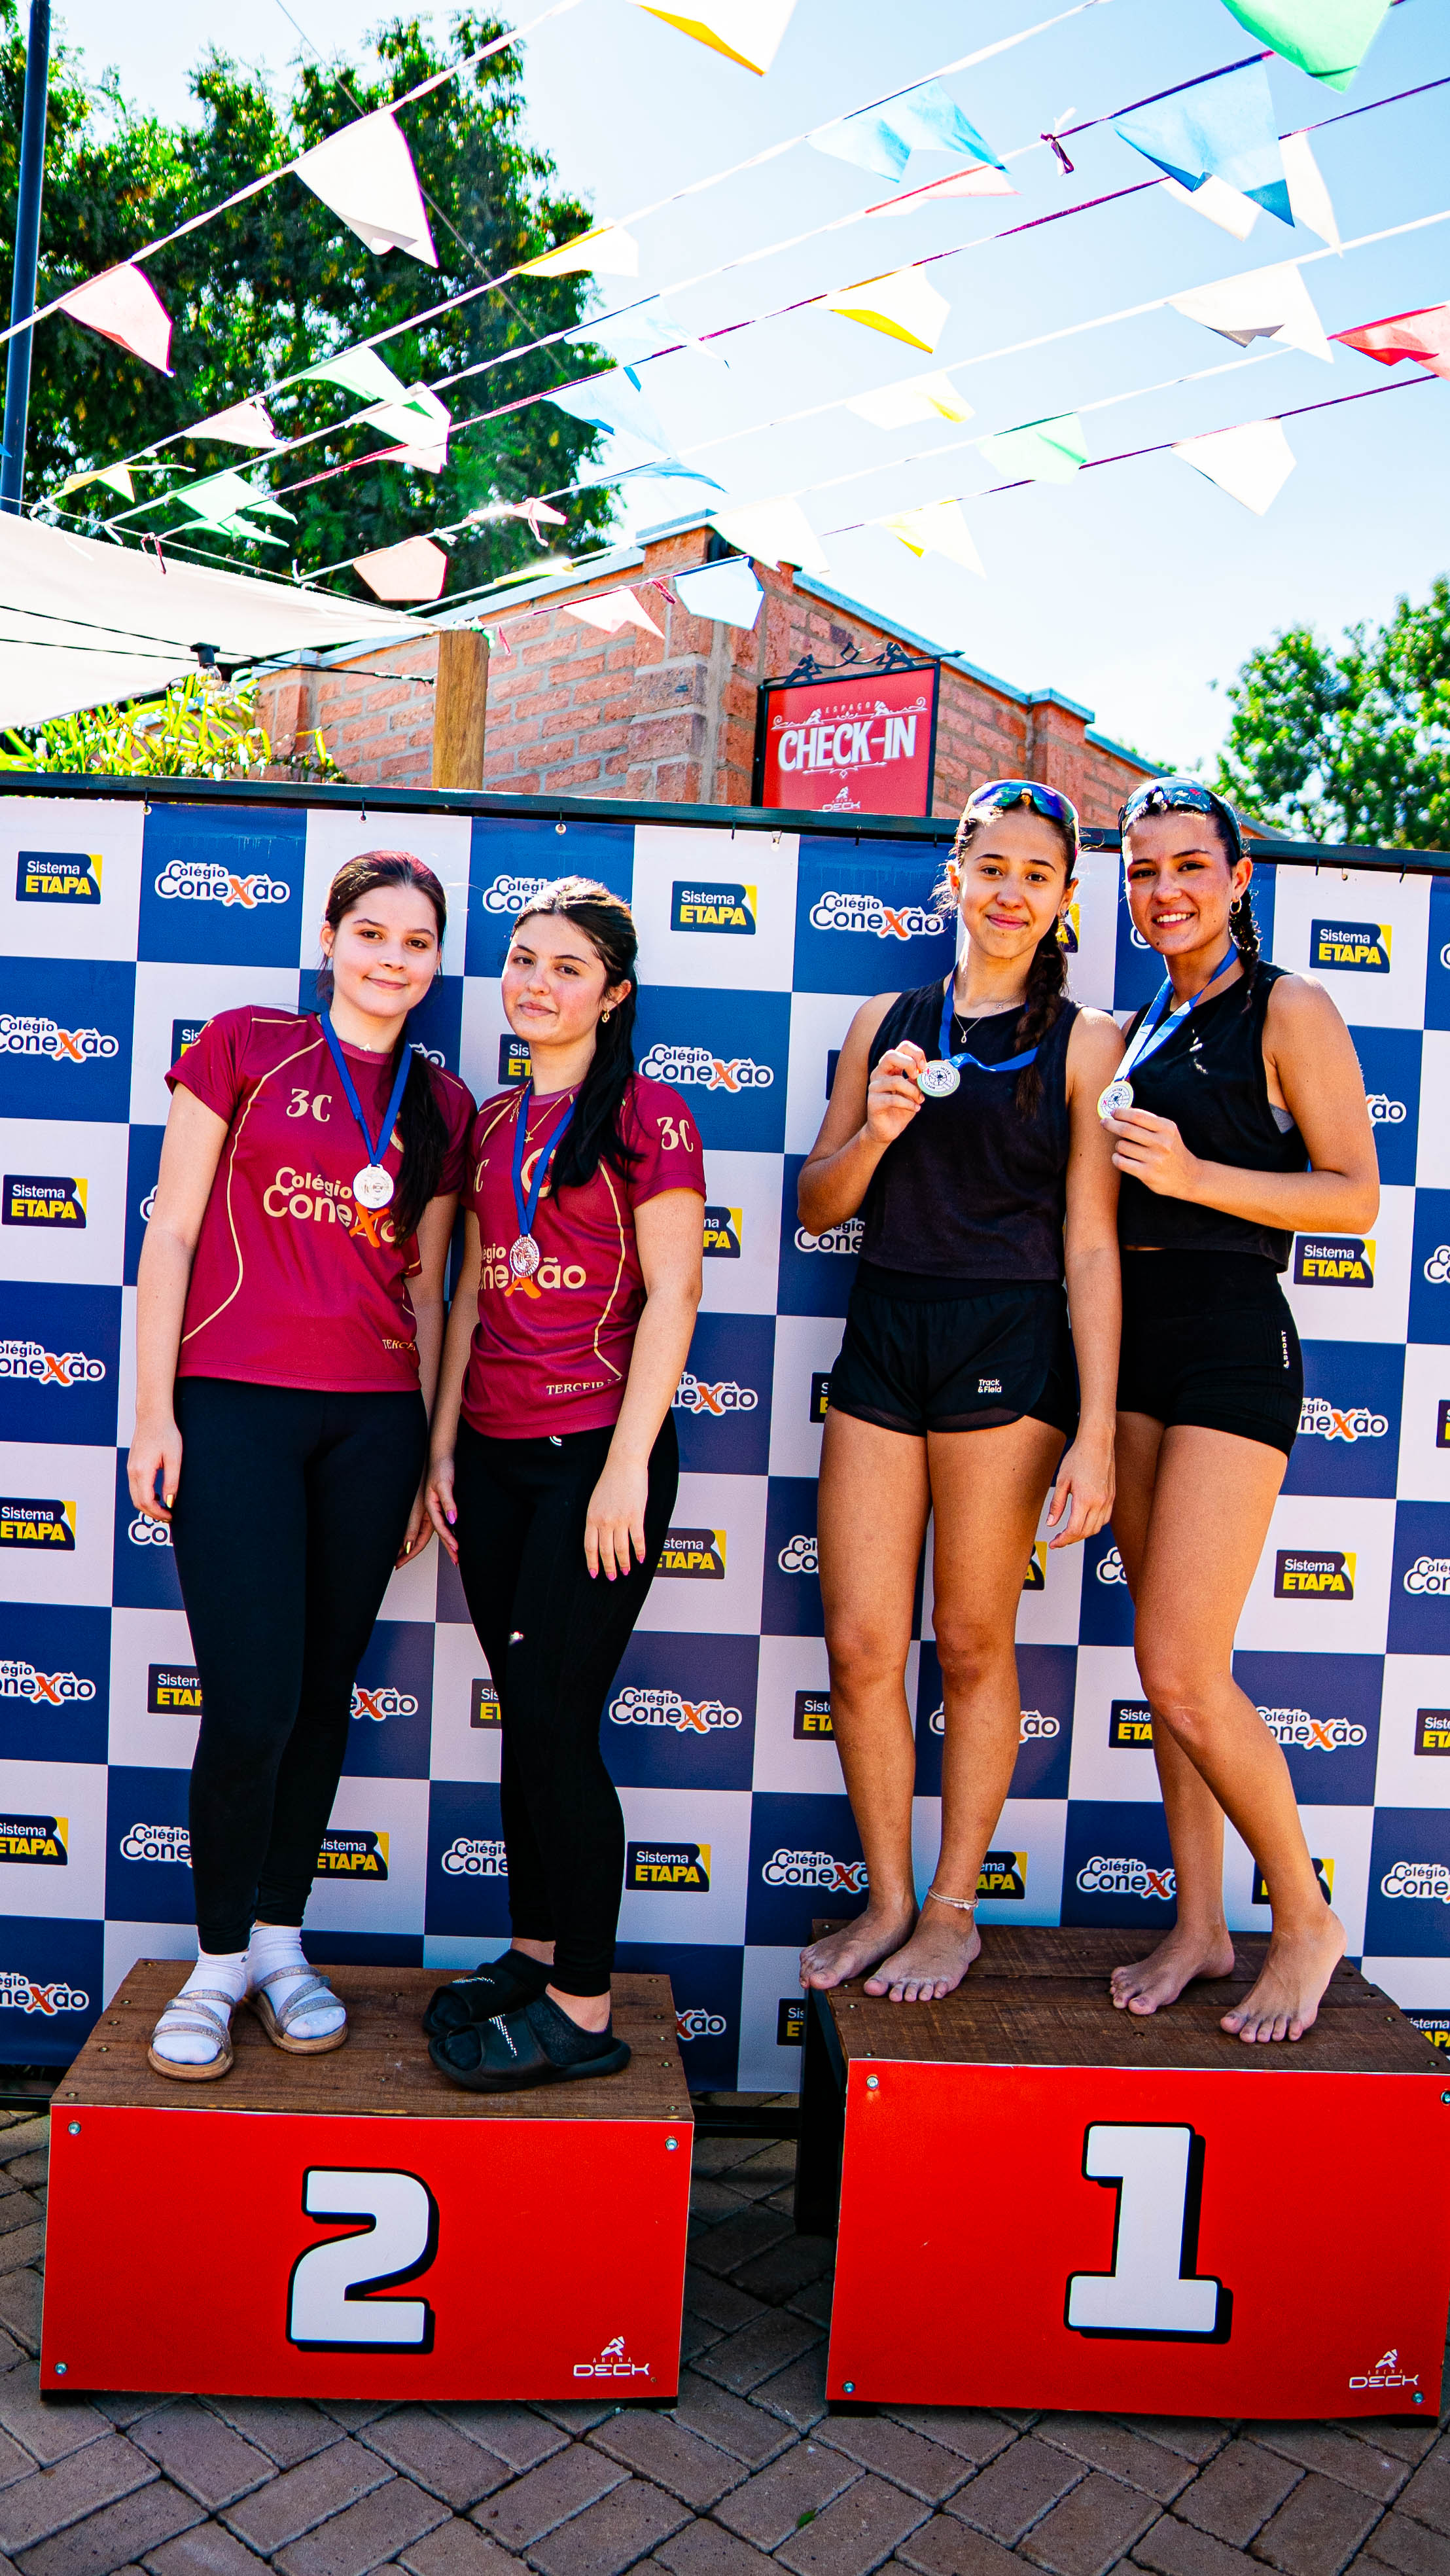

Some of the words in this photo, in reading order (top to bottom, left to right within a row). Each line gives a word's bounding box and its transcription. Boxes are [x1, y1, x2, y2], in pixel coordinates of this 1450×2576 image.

[825, 702, 871, 714] ESPAÇO
[778, 715, 917, 771] CHECK-IN
[822, 801, 860, 812] DECK
[27, 860, 80, 875] Sistema
[169, 862, 225, 879] Colégio
[26, 875, 92, 895] ETAPA
[497, 878, 544, 895] Colégi
[681, 890, 735, 904] Sistema
[824, 895, 879, 910] Colégio
[680, 905, 747, 926] ETAPA
[1320, 928, 1370, 944] Sistema
[1318, 943, 1381, 965] ETAPA
[653, 1047, 709, 1063] Colégio
[286, 1088, 332, 1122] 3C
[657, 1117, 694, 1152] 3C
[275, 1167, 353, 1198] Colégio
[12, 1184, 65, 1199] Sistema
[11, 1199, 77, 1219] ETAPA
[797, 1229, 863, 1251] Cone
[1304, 1245, 1354, 1259] Sistema
[1303, 1259, 1365, 1279] ETAPA
[1, 1507, 54, 1520] Sistema
[1, 1521, 65, 1541] ETAPA
[663, 1538, 704, 1550] stema
[1284, 1558, 1335, 1572] Sistema
[1417, 1559, 1450, 1574] Colé
[1283, 1573, 1345, 1592] ETAPA
[1, 1663, 33, 1675] égio
[622, 1690, 678, 1706] Colégio
[804, 1700, 830, 1713] Sist
[1120, 1709, 1150, 1722] Siste
[1118, 1723, 1153, 1741] ETA
[133, 1825, 189, 1842] Colégio
[123, 1837, 191, 1857] Cone
[321, 1839, 366, 1851] istema
[318, 1852, 378, 1871] ETAPA
[445, 1852, 508, 1874] Cone
[637, 1851, 688, 1864] Sistema
[775, 1851, 831, 1867] Colégio
[635, 1865, 700, 1883] ETAPA
[1089, 1859, 1143, 1874] Colégio
[1394, 1865, 1446, 1880] Colégio
[976, 1874, 1016, 1890] APA
[1384, 1875, 1448, 1896] Cone
[1065, 2122, 1226, 2338] 1
[288, 2168, 434, 2350] 2
[573, 2363, 650, 2376] DECK
[1349, 2374, 1419, 2388] DECK
